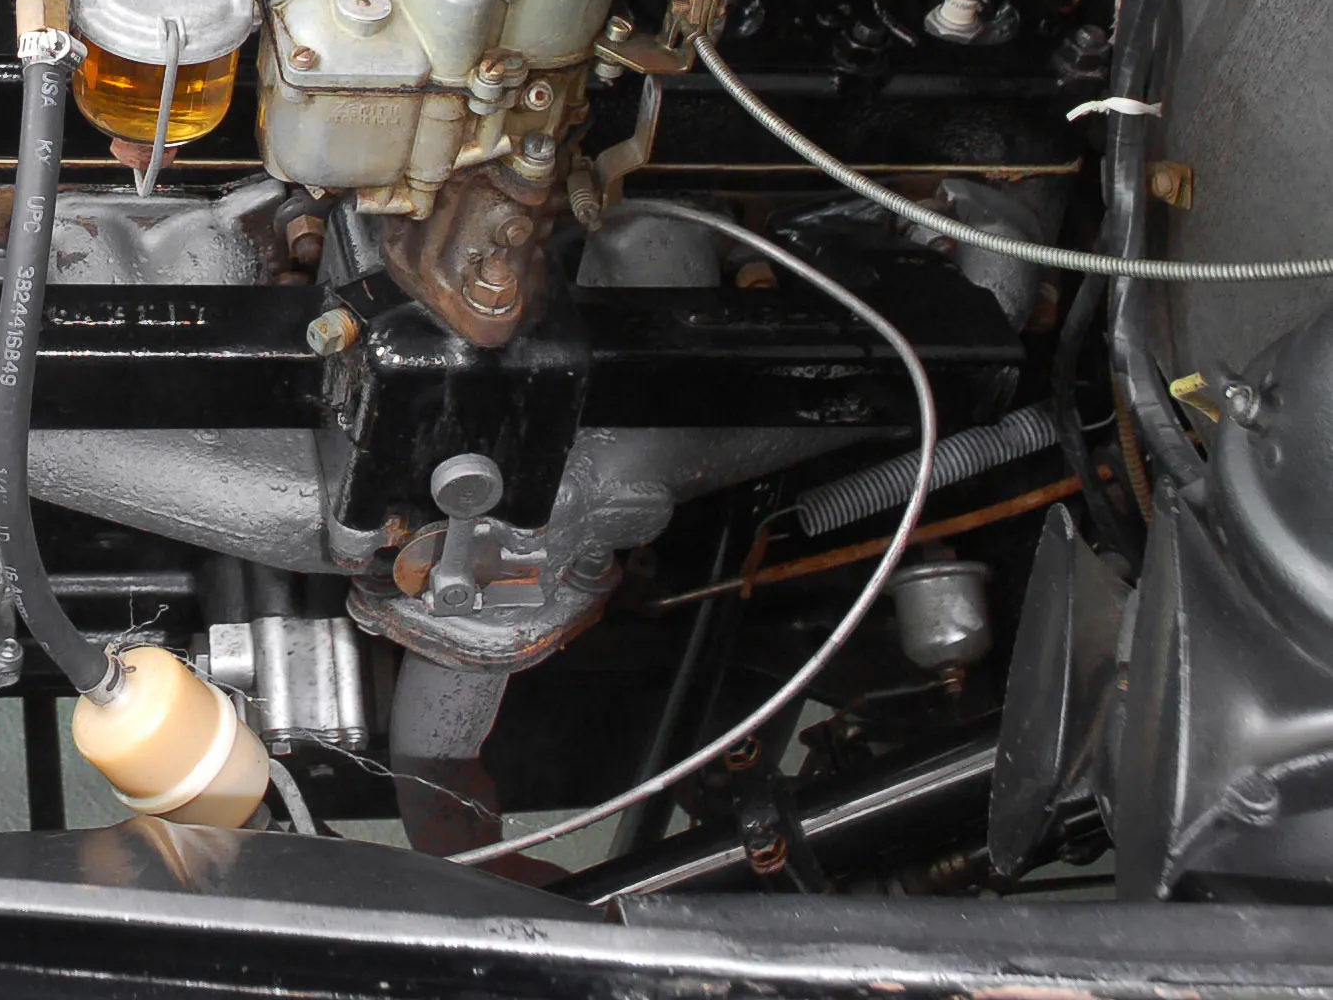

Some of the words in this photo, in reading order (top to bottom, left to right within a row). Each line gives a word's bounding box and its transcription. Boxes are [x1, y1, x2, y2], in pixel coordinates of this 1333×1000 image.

[41, 71, 59, 107] USA
[36, 139, 53, 168] KY
[23, 196, 45, 233] UPC
